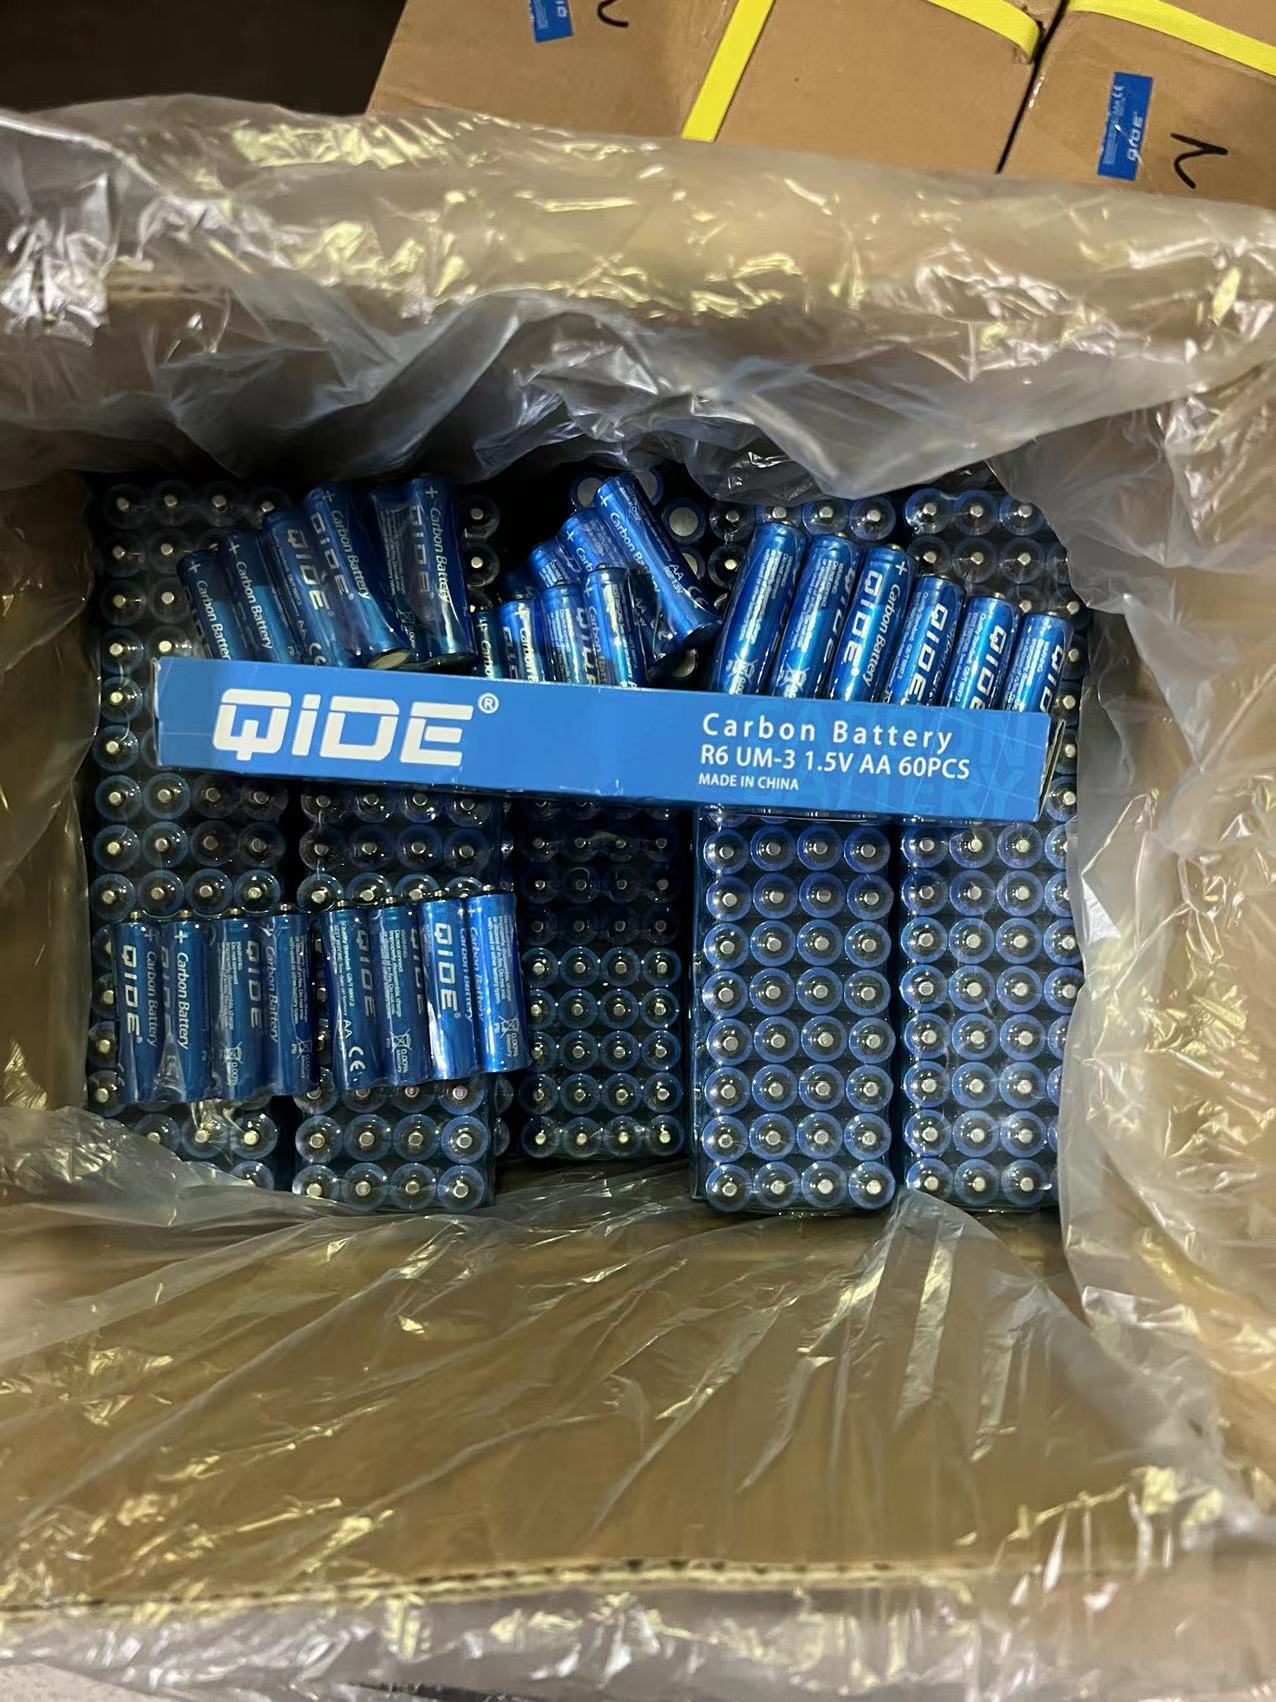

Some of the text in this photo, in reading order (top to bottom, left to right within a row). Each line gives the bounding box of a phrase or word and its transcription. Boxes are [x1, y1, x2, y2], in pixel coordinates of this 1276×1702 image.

[331, 510, 371, 600] Carbon Battery
[430, 507, 444, 553] Carbon
[574, 545, 594, 573] Carb
[610, 512, 635, 551] Carbon
[667, 561, 685, 580] AA
[197, 580, 232, 661] Carbon Batter
[236, 561, 273, 649] Carbon Battery
[840, 569, 884, 667] QIDE
[859, 583, 902, 687] Carbon Battery
[905, 602, 949, 701] QIDE
[700, 744, 970, 780] R6 UM-3 1.5V AA 60PCS
[702, 713, 952, 755] Carbon Battery
[698, 772, 798, 791] MADE IN CHINA
[121, 943, 140, 1037] QIDE
[144, 950, 159, 1048] Carbon Battery
[176, 952, 190, 1050] Carbon Battery
[245, 939, 263, 1029] QIDE
[265, 946, 281, 1043] Carbon Battery
[355, 929, 375, 1018] QIDE
[433, 921, 457, 1012] QIDE
[343, 1018, 352, 1038] AA
